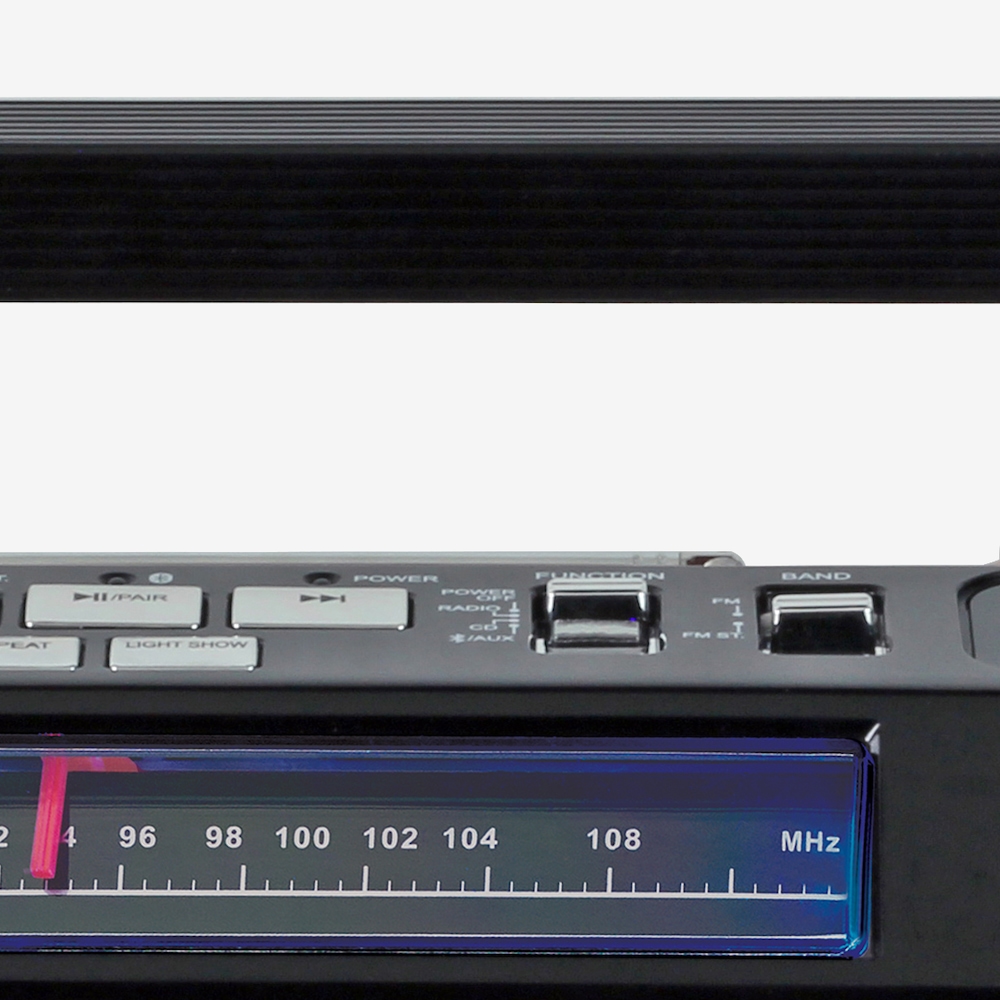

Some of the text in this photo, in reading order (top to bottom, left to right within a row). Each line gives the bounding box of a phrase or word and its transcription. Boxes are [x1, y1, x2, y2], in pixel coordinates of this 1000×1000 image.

[353, 575, 439, 583] POWER
[535, 572, 665, 580] FUNCTION
[781, 572, 851, 580] BAND
[125, 641, 248, 649] LIGHT SHOW
[119, 825, 157, 848] 96
[205, 826, 242, 849] 98
[275, 826, 330, 849] 100
[363, 827, 418, 849] 102
[443, 827, 498, 850] 104
[587, 828, 641, 851] 108
[780, 830, 841, 853] MHz
